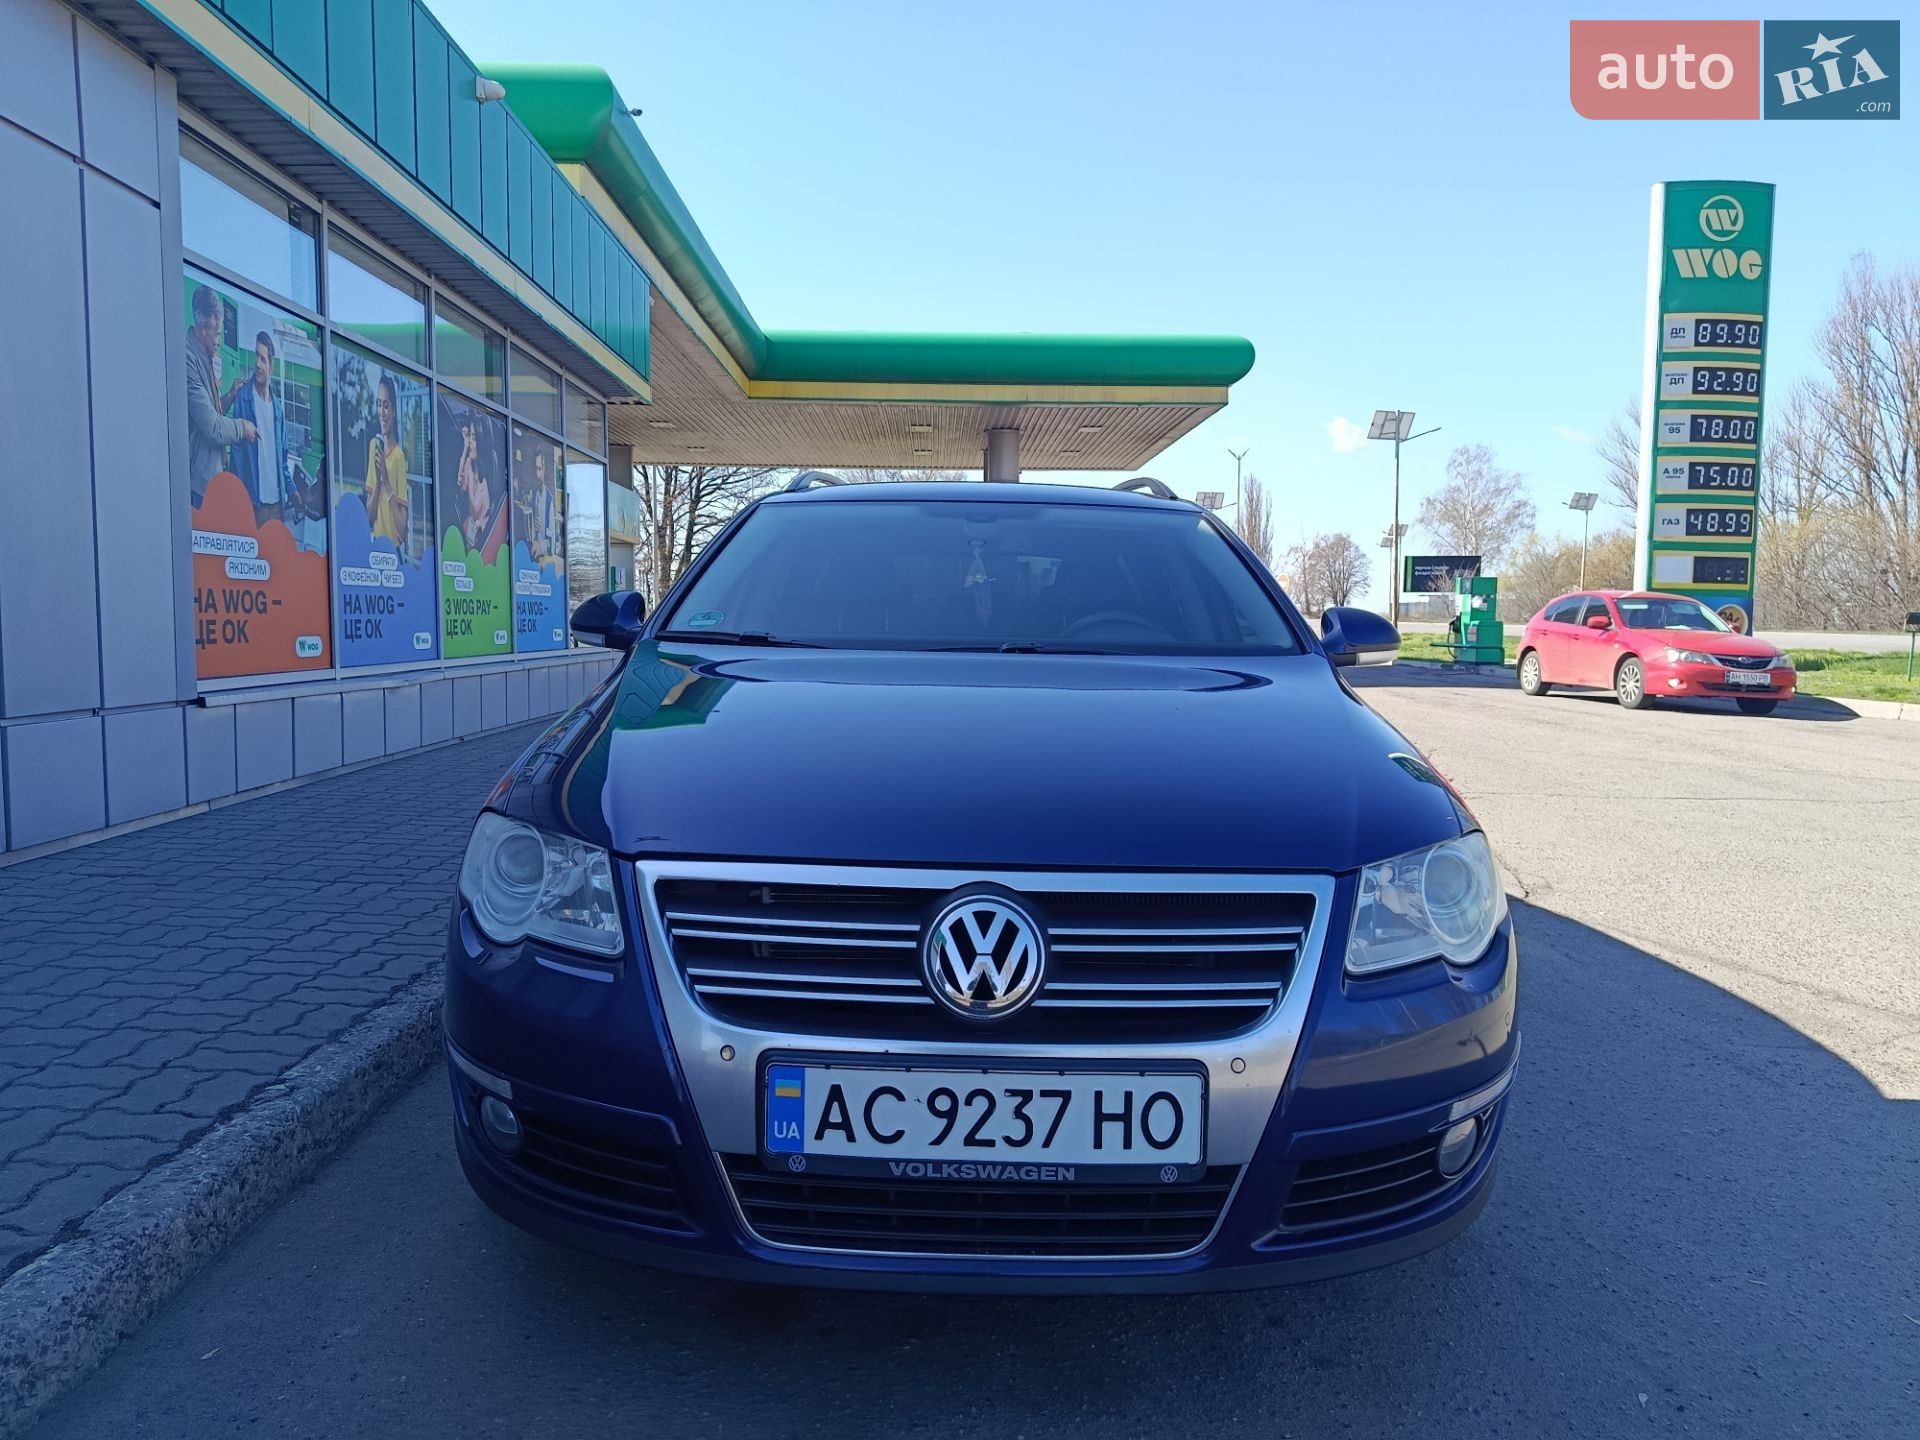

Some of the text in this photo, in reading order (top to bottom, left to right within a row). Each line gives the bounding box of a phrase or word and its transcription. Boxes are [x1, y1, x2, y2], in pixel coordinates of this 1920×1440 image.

[1671, 248, 1763, 280] WOG
[1697, 323, 1760, 345] 89.90
[1697, 371, 1757, 392] 92.90
[1668, 418, 1755, 440] 95 78.00
[1695, 466, 1753, 487] 75.00
[1661, 512, 1751, 533] ГАЗ 48.99
[193, 535, 255, 554] АПРАВЛЯТИСЯ
[222, 588, 268, 615] WOG
[343, 593, 362, 615] НА
[365, 594, 395, 615] WOG
[453, 598, 475, 616] WOG
[476, 599, 491, 616] PAY
[344, 618, 362, 643] ЦЕ
[813, 1083, 1184, 1151] AC 9237 HO
[773, 1121, 800, 1140] UA
[888, 1161, 1075, 1182] VOLKSWAGEN
